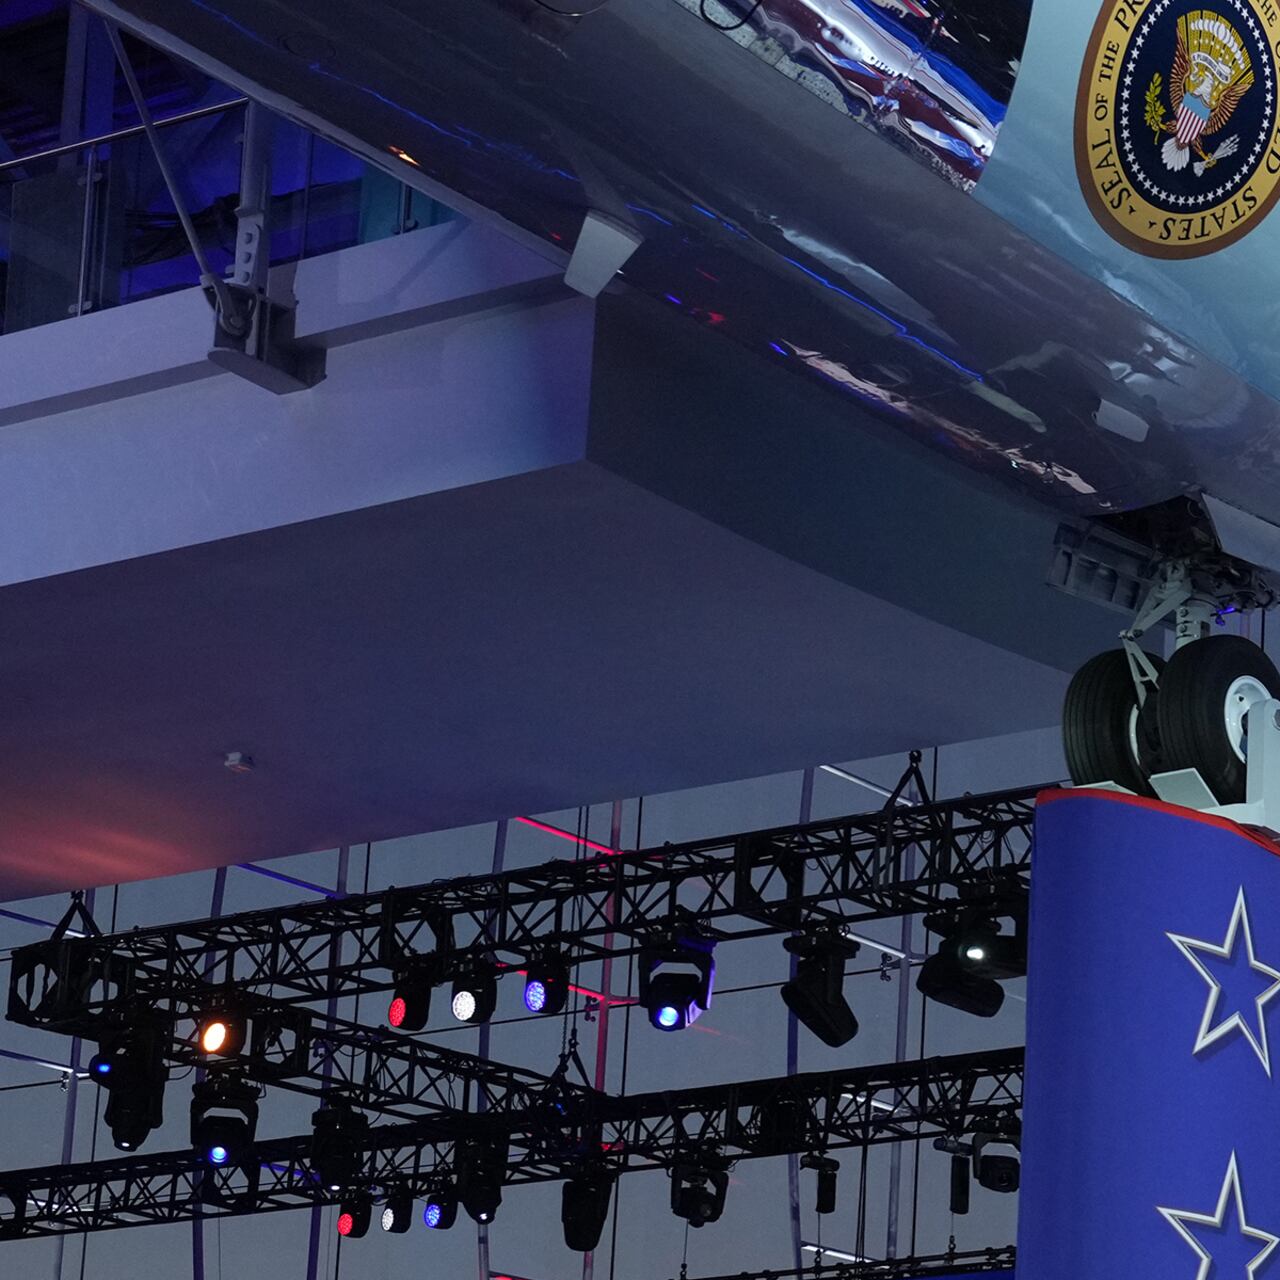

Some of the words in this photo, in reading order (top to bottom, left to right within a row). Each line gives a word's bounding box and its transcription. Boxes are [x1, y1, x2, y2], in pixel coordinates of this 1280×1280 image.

[1256, 0, 1277, 28] HE
[1098, 41, 1120, 84] THE
[1094, 93, 1109, 121] OF
[1092, 128, 1132, 210] SEAL
[1158, 186, 1259, 241] STATES
